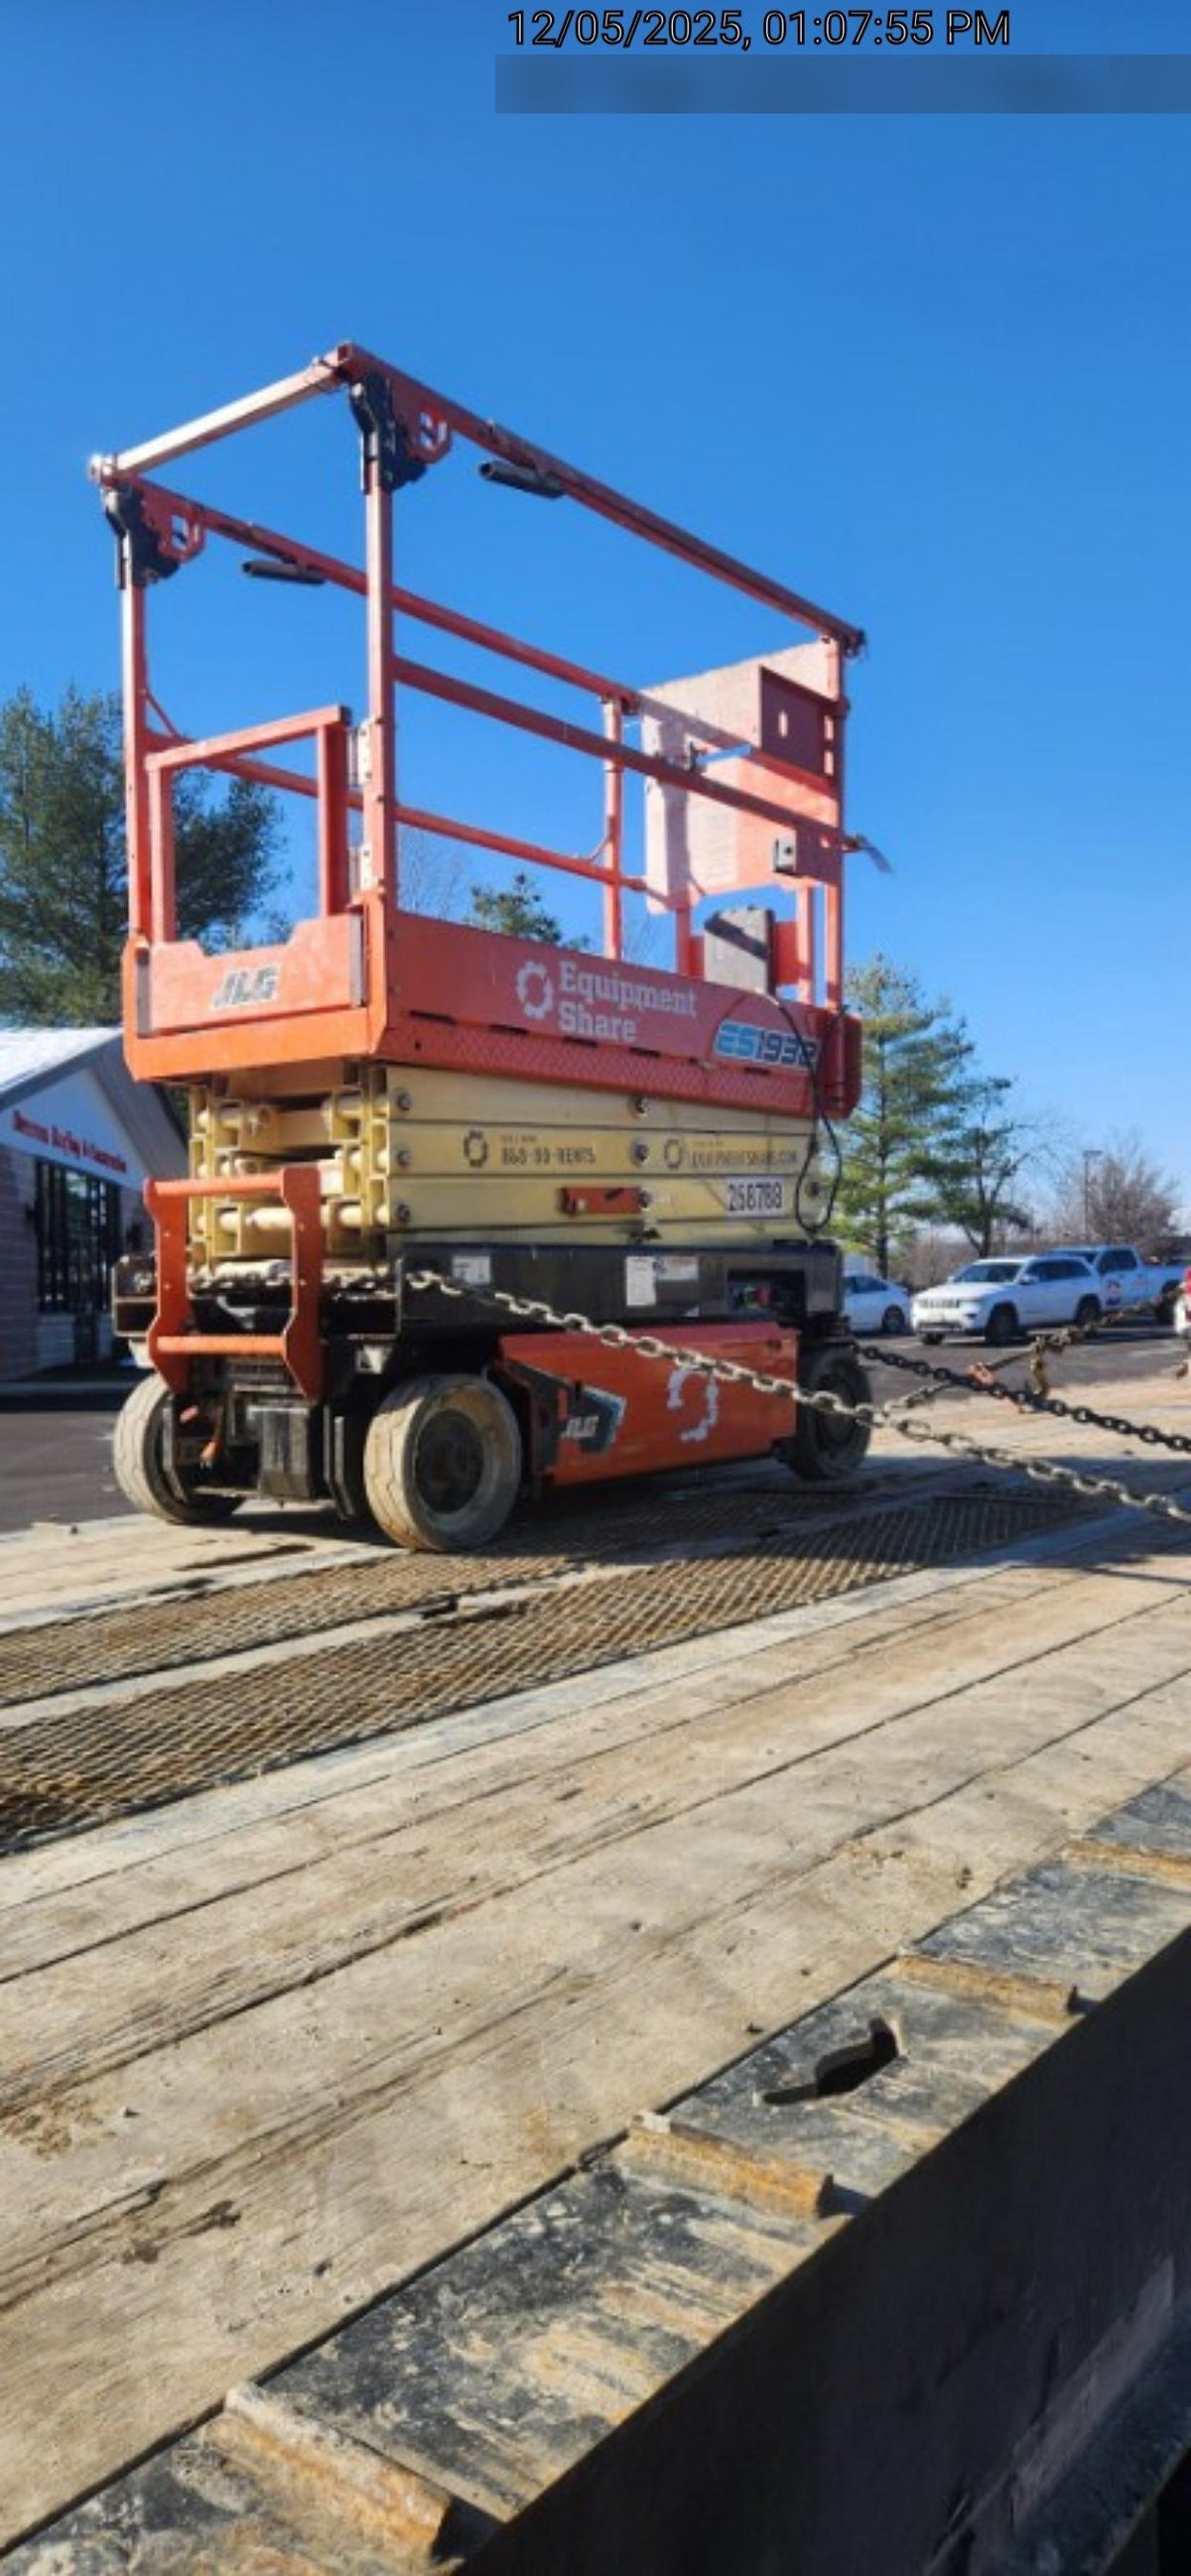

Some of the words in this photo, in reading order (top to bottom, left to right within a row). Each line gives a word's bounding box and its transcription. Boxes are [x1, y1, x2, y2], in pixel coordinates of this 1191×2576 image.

[213, 966, 279, 1008] JLG
[559, 961, 697, 1018] Equipment
[558, 1001, 636, 1042] Share
[561, 1415, 599, 1440] JLG
